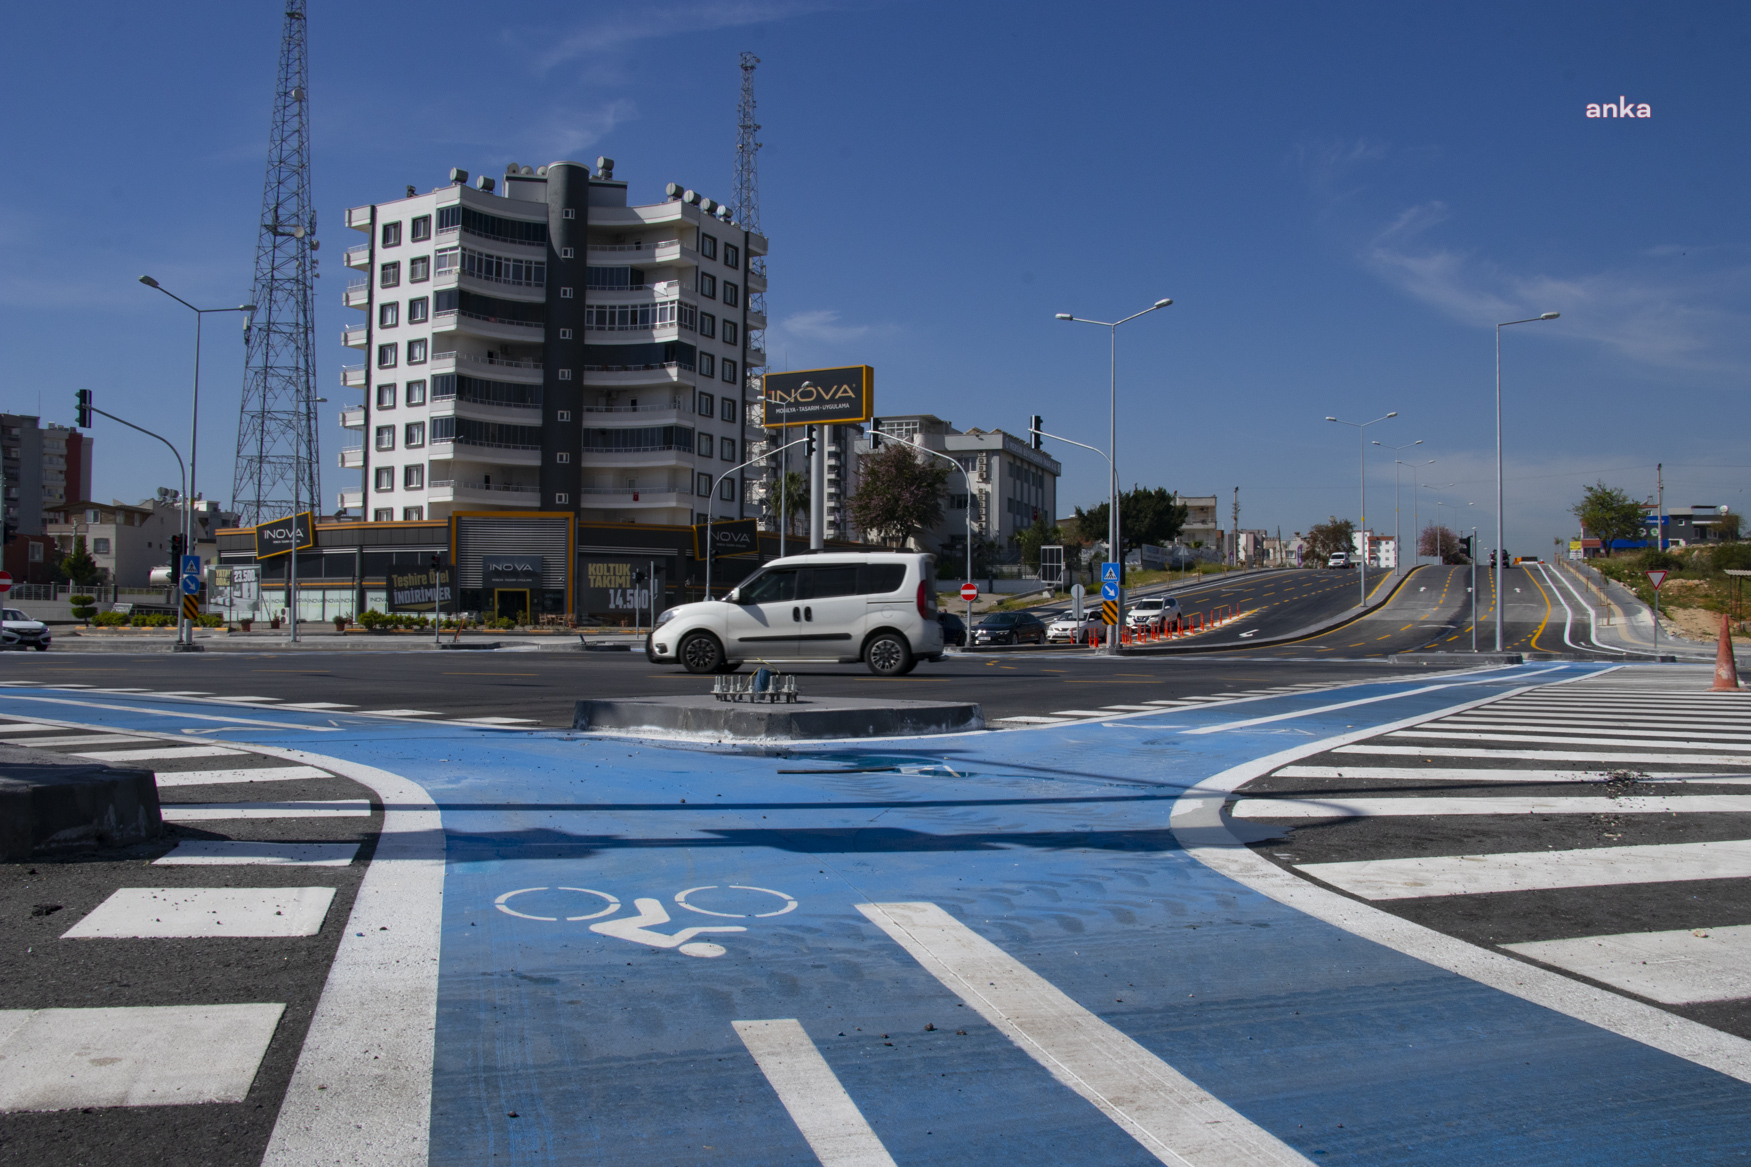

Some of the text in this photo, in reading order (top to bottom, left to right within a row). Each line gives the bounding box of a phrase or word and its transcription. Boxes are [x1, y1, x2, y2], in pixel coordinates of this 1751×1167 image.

[709, 530, 750, 542] NOVA
[489, 563, 533, 571] INOVA
[588, 564, 631, 576] KOLTUK
[392, 569, 450, 588] Teşhire Öel
[588, 576, 631, 588] TAKIMI
